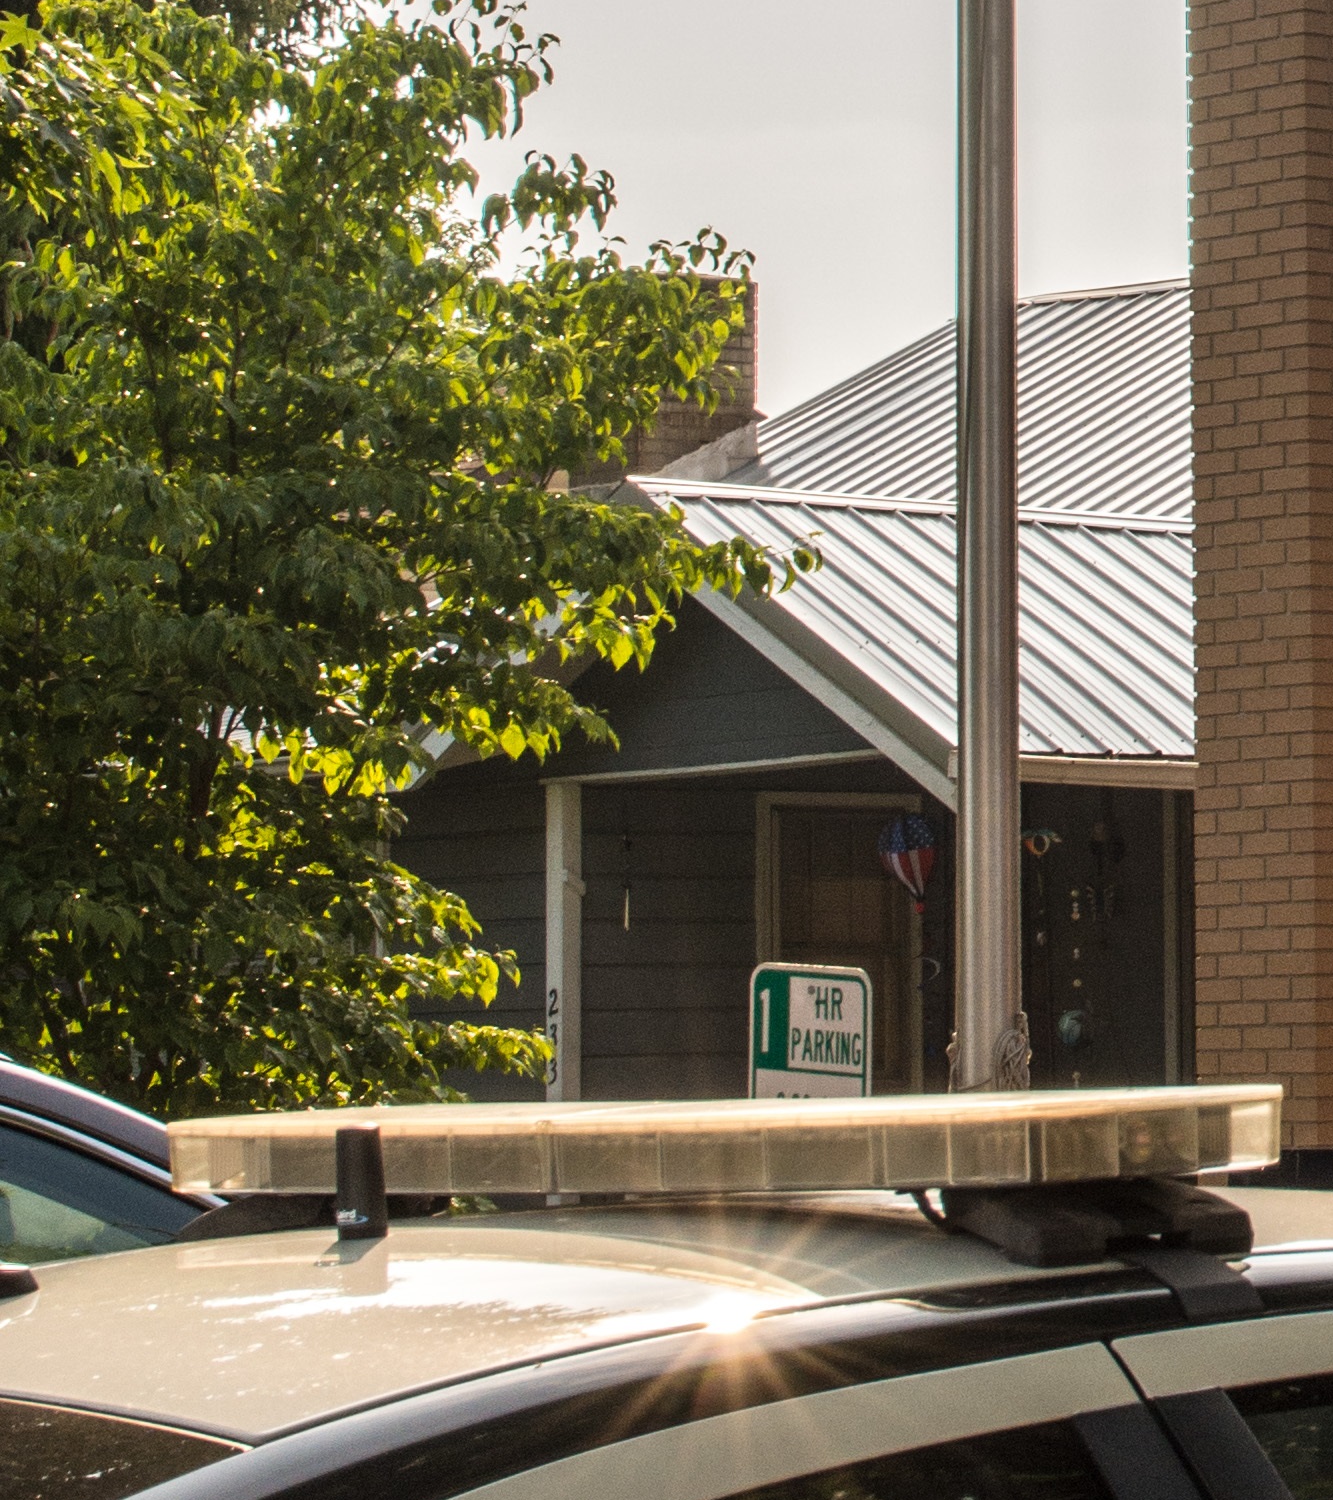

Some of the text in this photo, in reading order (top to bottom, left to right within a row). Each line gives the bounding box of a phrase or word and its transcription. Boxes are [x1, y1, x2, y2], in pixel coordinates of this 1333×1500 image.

[759, 986, 843, 1054] 1 HR
[791, 1027, 862, 1066] PARKING
